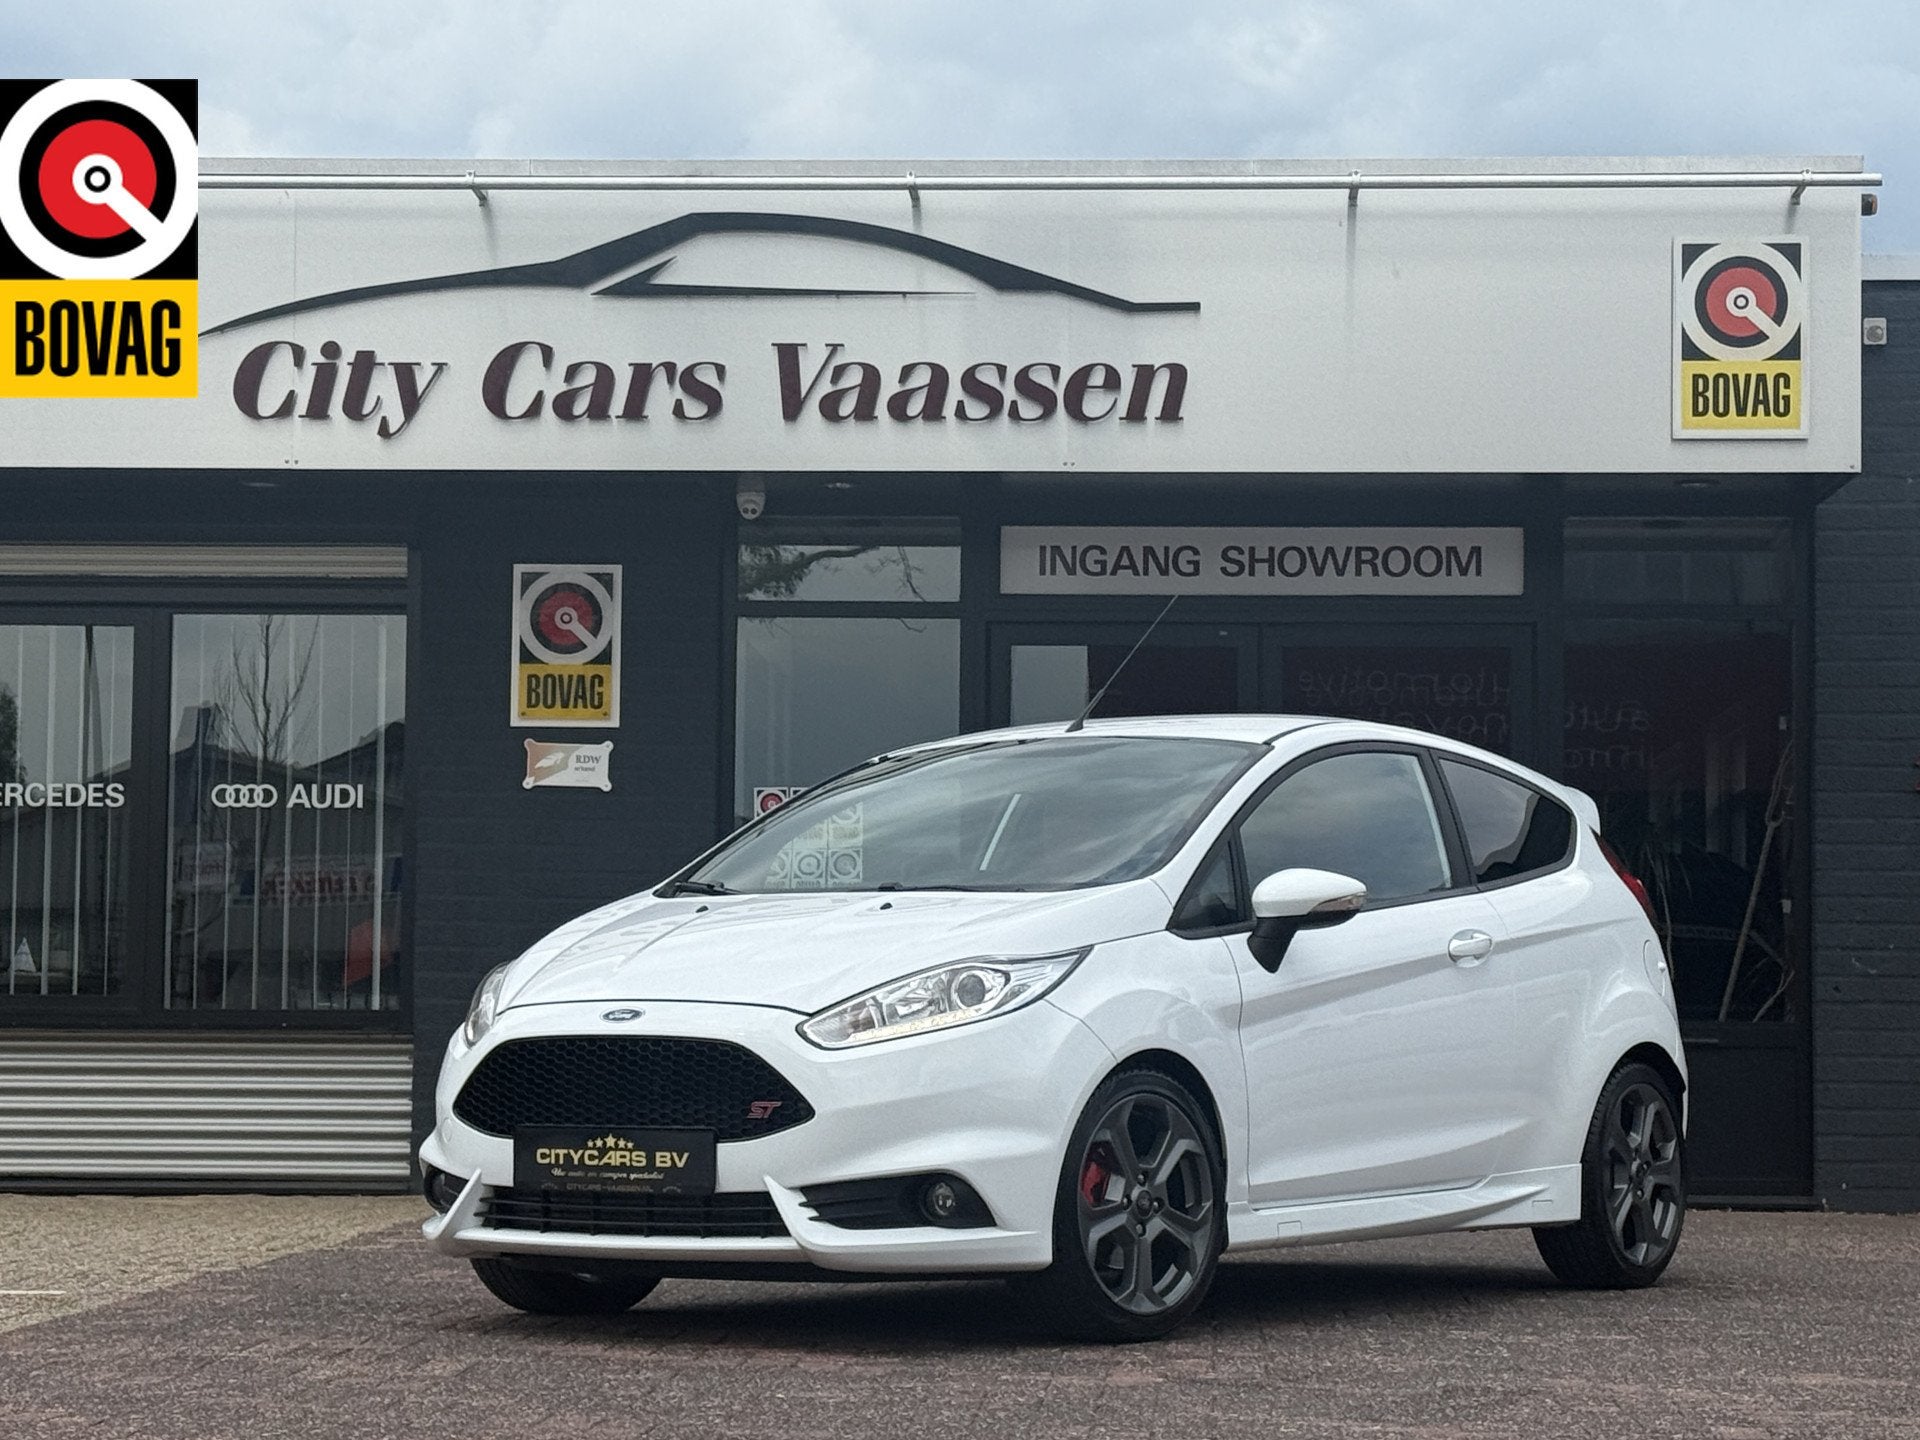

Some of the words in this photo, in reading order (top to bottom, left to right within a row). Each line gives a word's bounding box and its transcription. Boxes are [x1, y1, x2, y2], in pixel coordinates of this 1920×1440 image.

[233, 340, 448, 440] City
[481, 340, 726, 422] Cars
[771, 342, 1190, 423] Vaassen
[1691, 372, 1791, 418] BOVAG
[1038, 544, 1201, 578] INGANG
[1220, 544, 1483, 578] SHOWROOM
[526, 673, 604, 710] BOVAG
[575, 754, 602, 764] RDW
[0, 782, 125, 808] RCEDES
[286, 783, 364, 809] AUDI
[746, 1101, 782, 1119] ST
[535, 1147, 647, 1168] CITYCARS
[655, 1151, 690, 1169] BV
